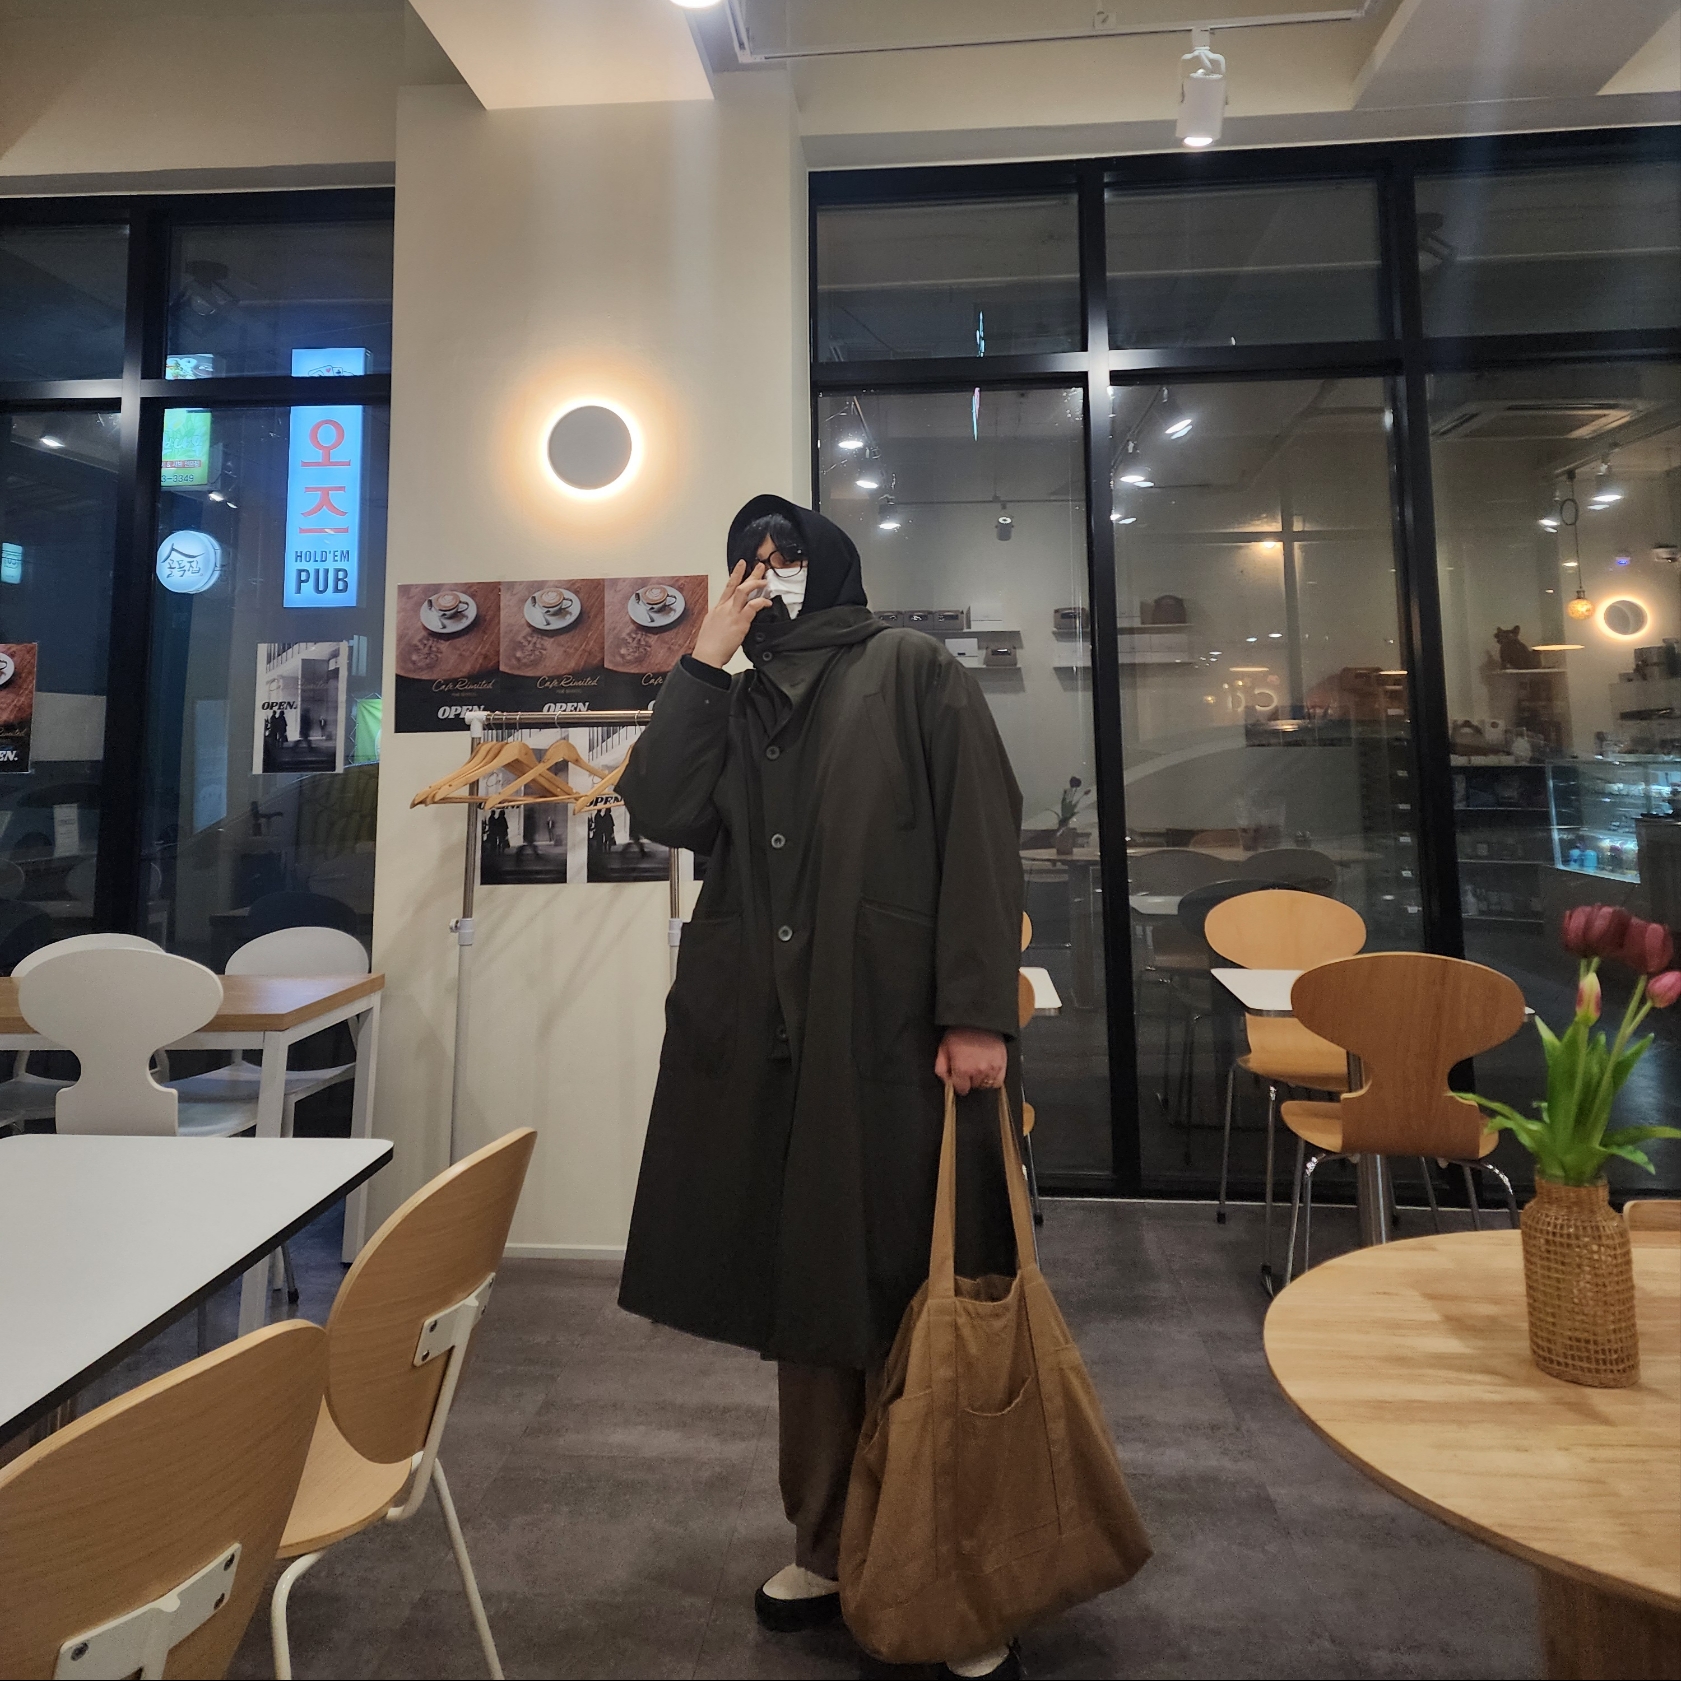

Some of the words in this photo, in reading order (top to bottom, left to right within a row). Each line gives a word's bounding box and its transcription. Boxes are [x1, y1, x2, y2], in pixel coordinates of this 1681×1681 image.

[299, 419, 352, 534] 오즈
[294, 550, 350, 563] HOLD'EM
[294, 568, 349, 595] PUB
[261, 701, 298, 711] OPEN.
